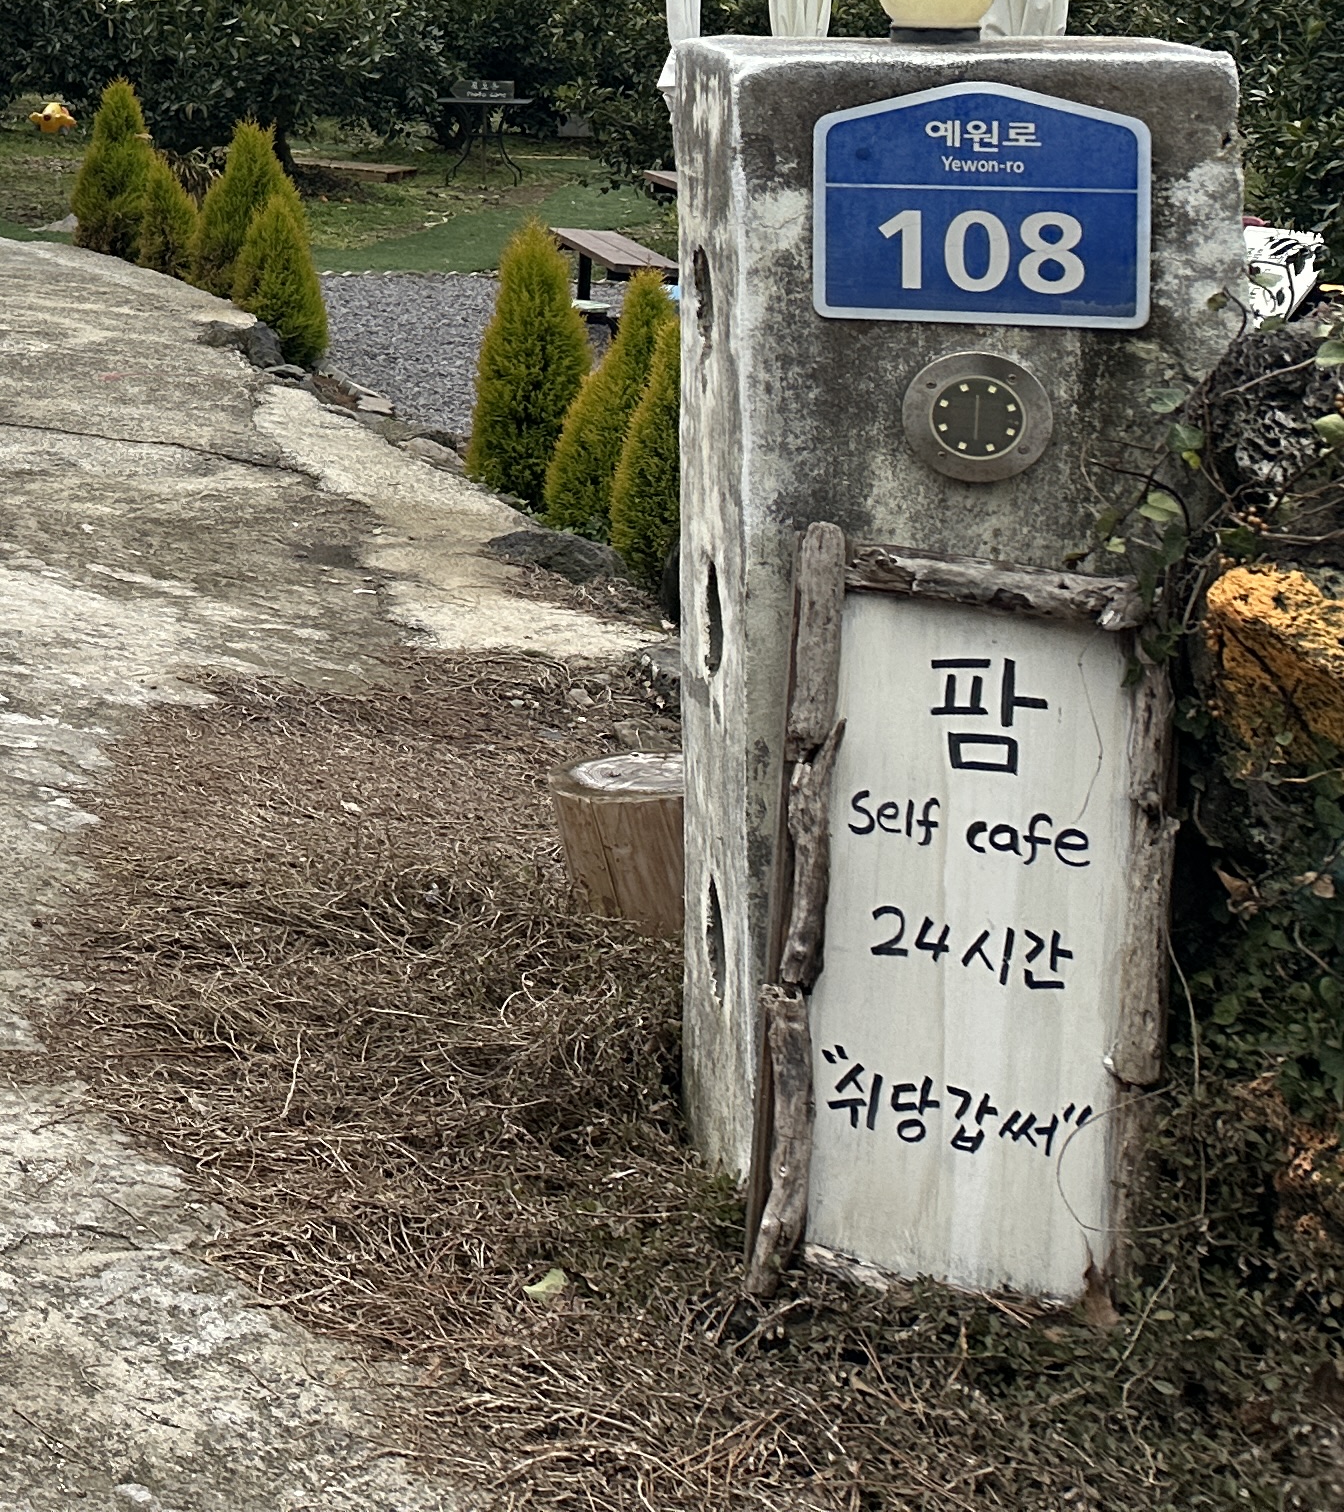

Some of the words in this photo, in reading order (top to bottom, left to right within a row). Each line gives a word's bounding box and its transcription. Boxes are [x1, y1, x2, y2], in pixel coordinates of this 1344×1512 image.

[925, 121, 1042, 153] 예원로
[941, 155, 1025, 174] Yewon-ro
[878, 209, 1086, 295] 108
[930, 657, 1048, 776] 팜
[848, 789, 941, 846] Self
[966, 813, 1091, 867] cafe
[870, 905, 1074, 989] 24시간
